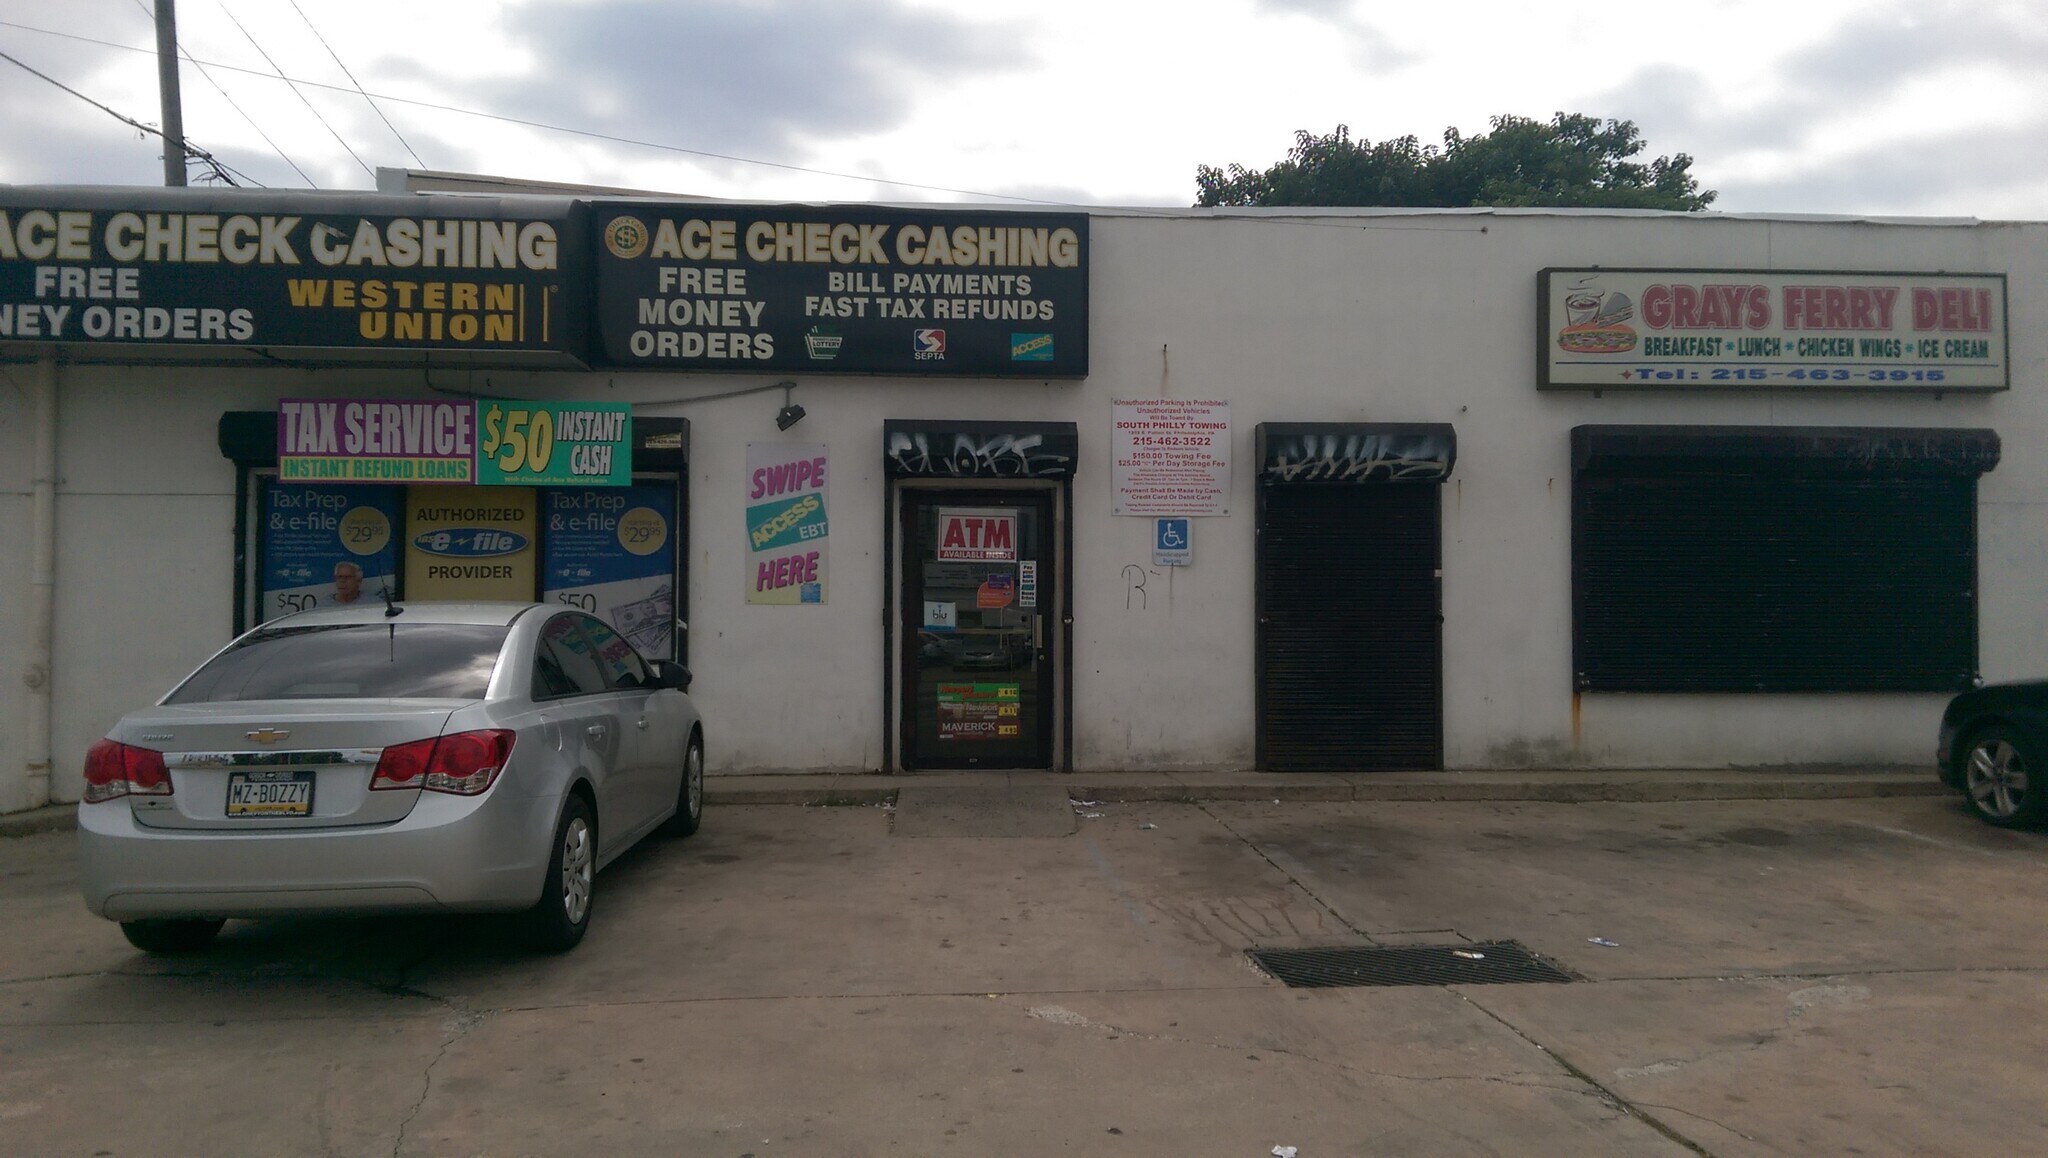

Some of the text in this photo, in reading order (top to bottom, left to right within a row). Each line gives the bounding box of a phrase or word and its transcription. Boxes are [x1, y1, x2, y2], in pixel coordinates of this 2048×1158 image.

[104, 212, 300, 264] CHECK
[310, 217, 557, 270] CASHING
[650, 218, 1079, 268] ACE CHECK CASHING
[35, 266, 140, 299] FREE
[659, 267, 746, 295] FREE
[828, 272, 1032, 296] BILL PAYMENTS
[288, 279, 513, 311] WESTERN
[638, 298, 766, 328] MONEY
[805, 296, 1054, 321] FAST TAX REFUNDS
[1641, 284, 1992, 333] GRAYS FERRY DELI
[82, 305, 254, 341] ORDERS
[360, 312, 513, 342] UNION
[630, 331, 775, 360] ORDERS
[914, 352, 945, 361] SEPTA
[1013, 334, 1053, 357] ACCESS
[1643, 336, 1989, 360] BREAKFAST LUNCH CHICKEN WINGS ICE CREAM
[1636, 368, 1945, 382] Tel: 215-463-3915
[281, 402, 471, 455] TAX SERVICE
[482, 404, 553, 473] $50
[557, 411, 626, 443] INSTANT
[1133, 436, 1211, 446] 215-462-3522
[283, 459, 467, 480] INSTANT REFUND LOANS
[570, 445, 613, 476] CASH
[1118, 459, 1141, 467] $25.00
[1182, 460, 1210, 468] Storage
[751, 457, 826, 499] SWIPE
[269, 490, 347, 512] Tax Prep
[550, 491, 625, 513] Tax Prep
[270, 512, 337, 530] & e-file
[417, 508, 525, 521] AUTHORIZED
[550, 512, 616, 531] & e-file
[752, 495, 819, 548] ACCESS
[799, 521, 827, 540] EBT
[943, 518, 1011, 549] ATM
[428, 566, 513, 579] PROVIDER
[756, 551, 820, 592] HERE
[966, 703, 998, 711] Newport
[942, 721, 996, 732] MAVERICK
[232, 783, 307, 804] MZ-BOZZY
